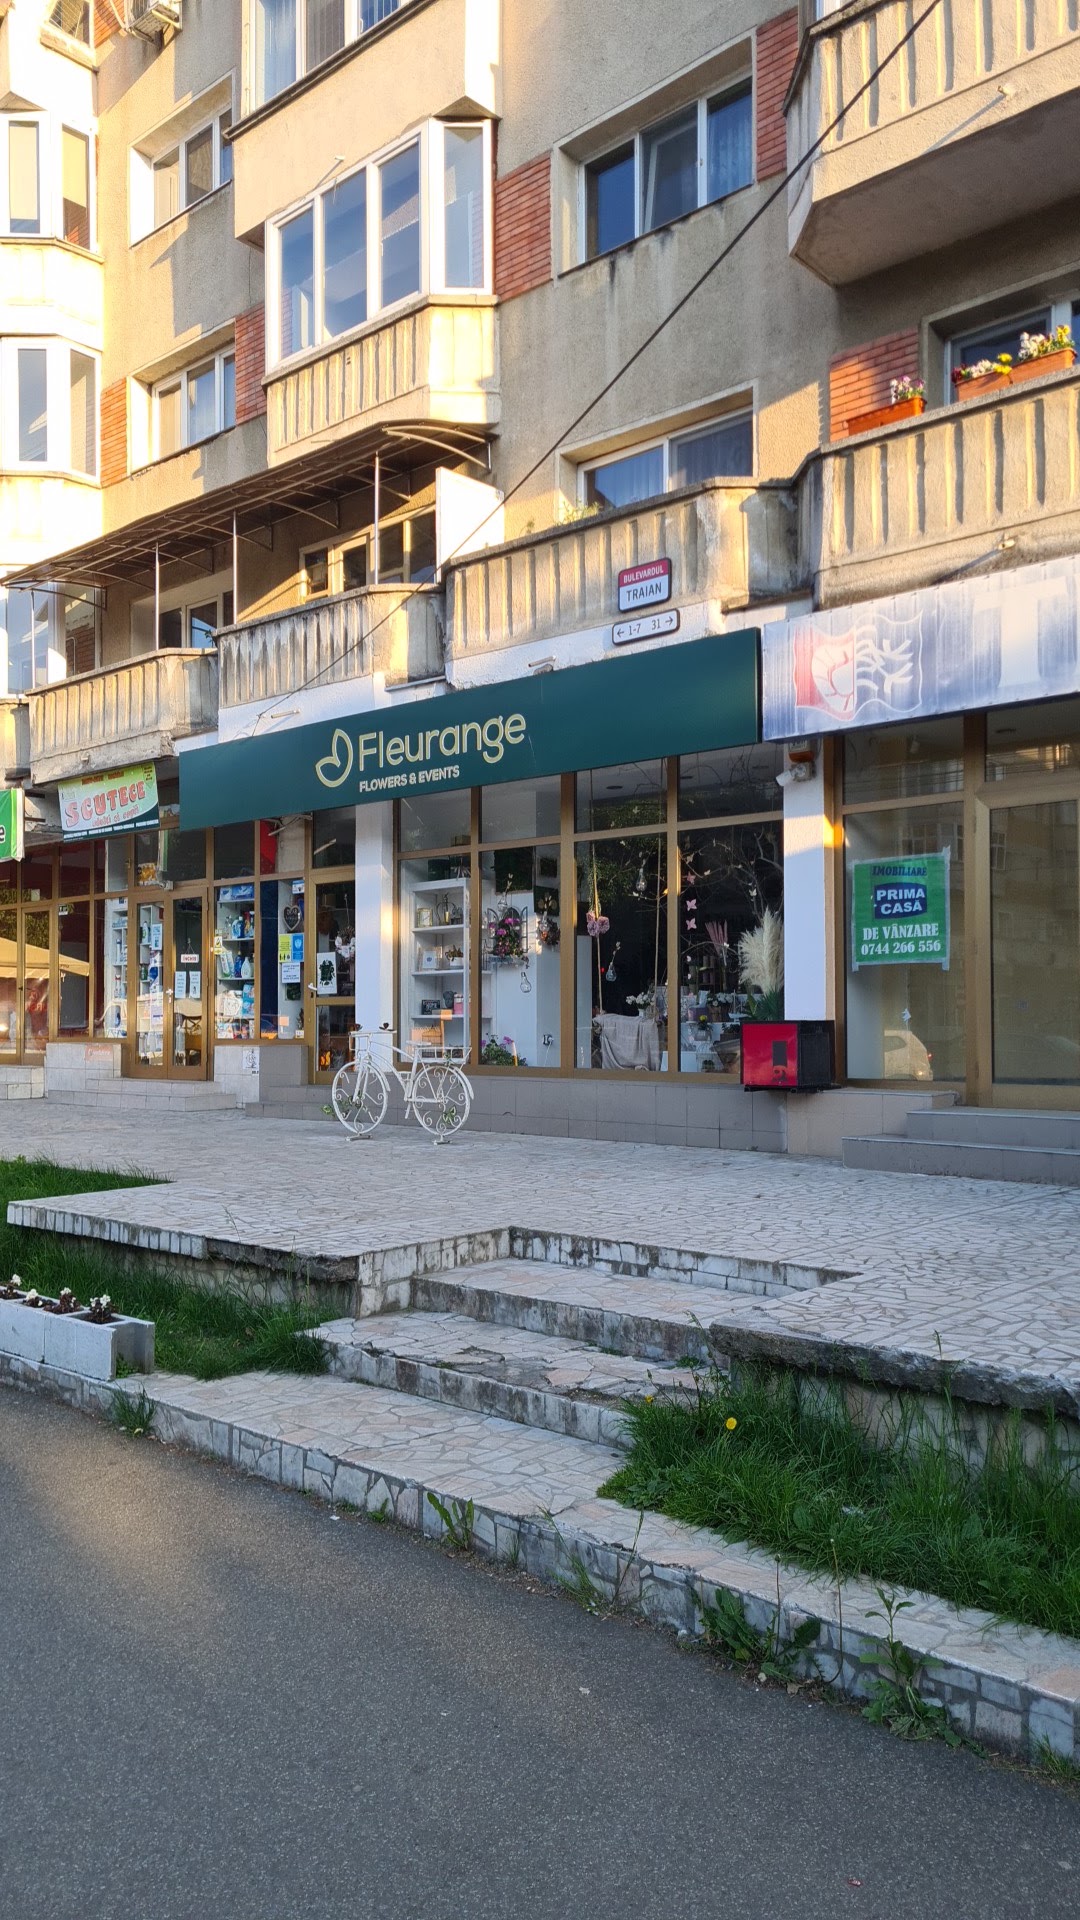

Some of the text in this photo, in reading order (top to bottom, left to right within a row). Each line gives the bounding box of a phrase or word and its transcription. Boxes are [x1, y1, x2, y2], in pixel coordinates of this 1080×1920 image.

[623, 565, 664, 583] BULEVARDUL
[626, 582, 662, 602] TRAIAN
[629, 618, 661, 635] 1-7 31
[358, 713, 527, 772] Fleurange
[359, 765, 460, 792] FLOWERS & EVENTS
[65, 781, 146, 828] SCUTECE
[872, 865, 928, 877] IMOBILIARE
[876, 888, 925, 901] PRIMA
[863, 927, 879, 940] DE
[861, 940, 941, 955] 0744 266 556
